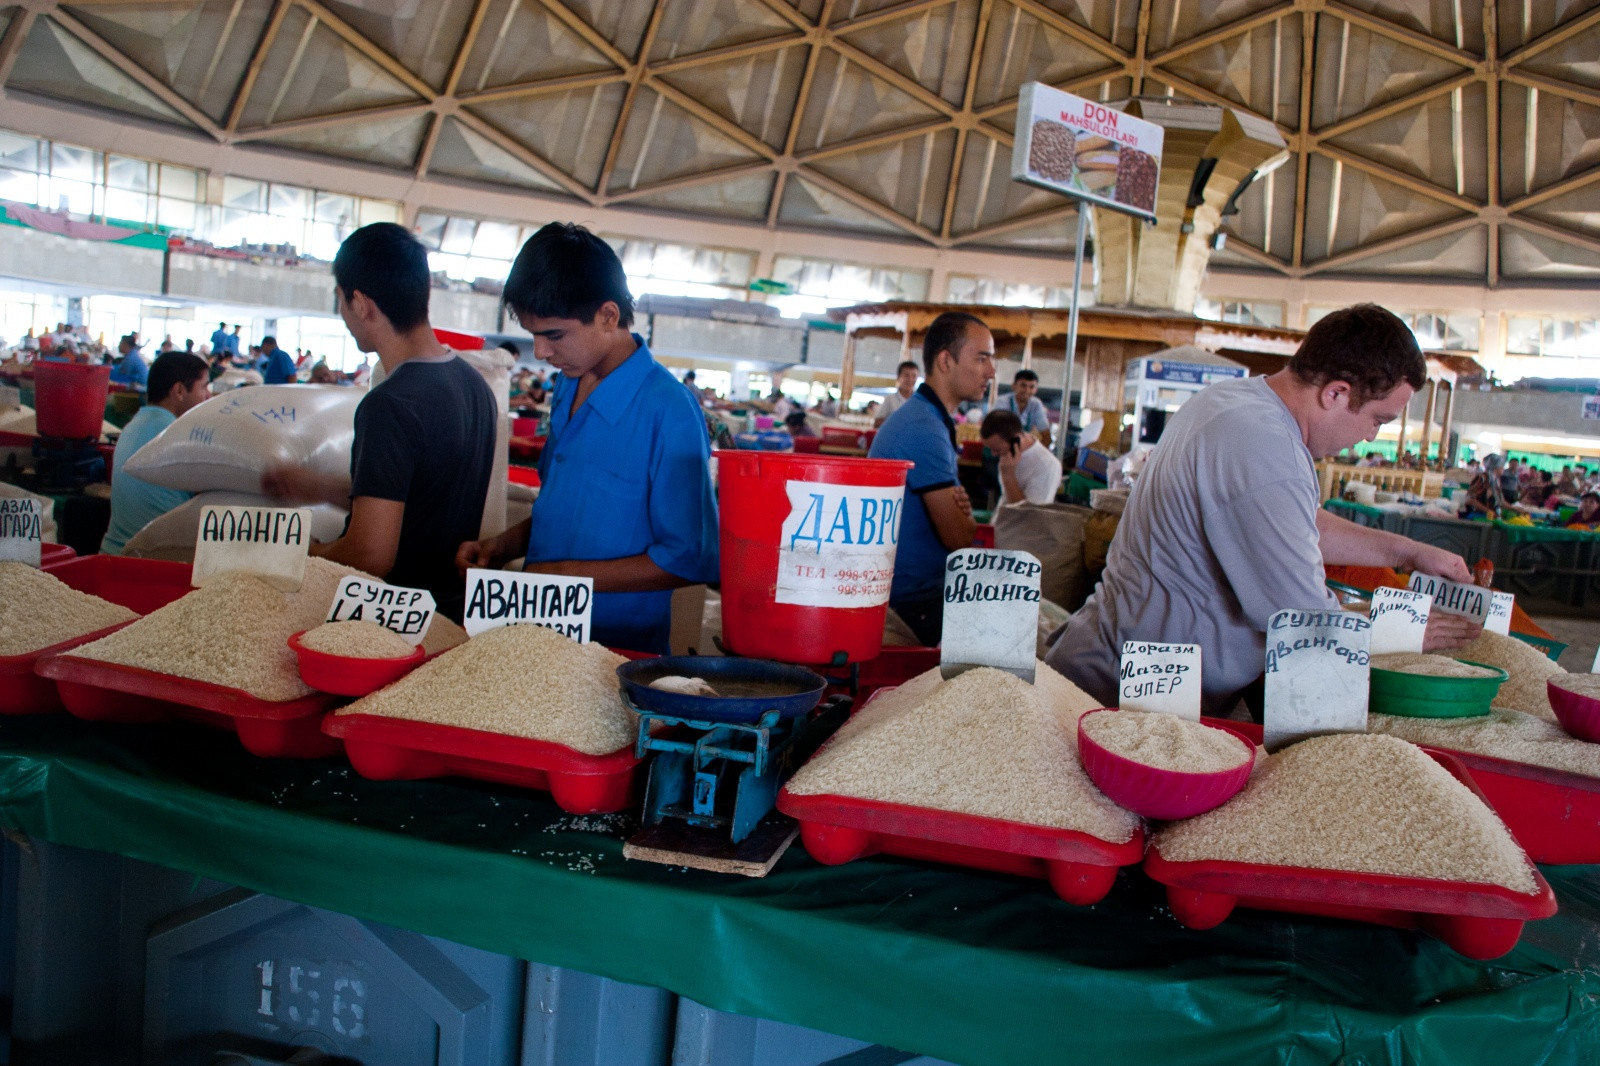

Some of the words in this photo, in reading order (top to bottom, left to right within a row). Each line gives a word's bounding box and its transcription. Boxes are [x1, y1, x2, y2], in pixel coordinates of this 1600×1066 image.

[1060, 111, 1138, 146] MAHSULOTLARI
[1084, 103, 1118, 128] DON
[203, 510, 302, 545] АЛАНГА
[345, 582, 422, 607] СУПЕР
[945, 574, 1040, 603] Аланга
[1123, 676, 1182, 698] СУПЕР
